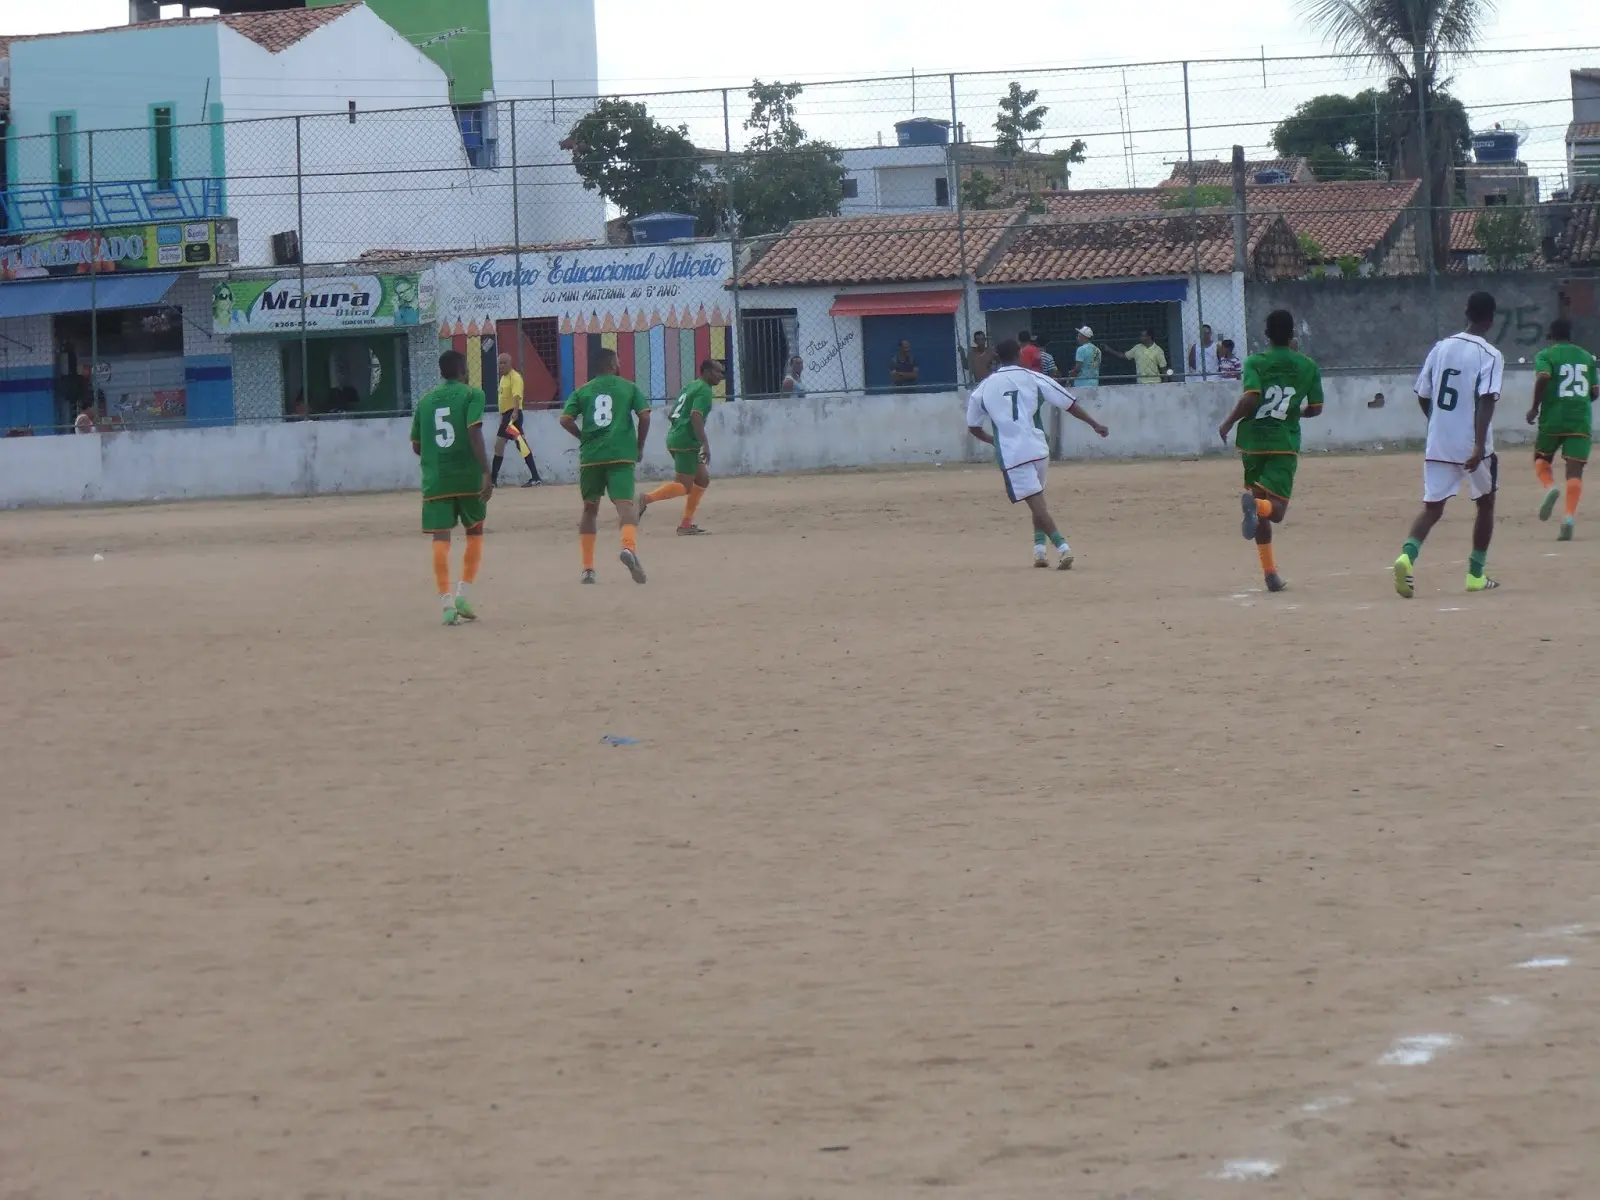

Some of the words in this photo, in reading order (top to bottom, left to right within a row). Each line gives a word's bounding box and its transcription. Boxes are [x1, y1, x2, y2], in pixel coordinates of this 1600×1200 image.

[469, 257, 541, 289] Centro
[547, 252, 656, 285] Educacional
[655, 252, 725, 280] Adição
[260, 291, 370, 310] Maura
[542, 291, 556, 303] DO
[558, 290, 580, 302] MINI
[582, 287, 626, 301] MATERNAL
[630, 287, 643, 298] AO
[1494, 305, 1543, 346] 75
[1437, 368, 1461, 411] 6
[1559, 363, 1589, 398] 25
[593, 394, 613, 427] 8
[671, 393, 687, 419] 2
[435, 407, 455, 448] 5
